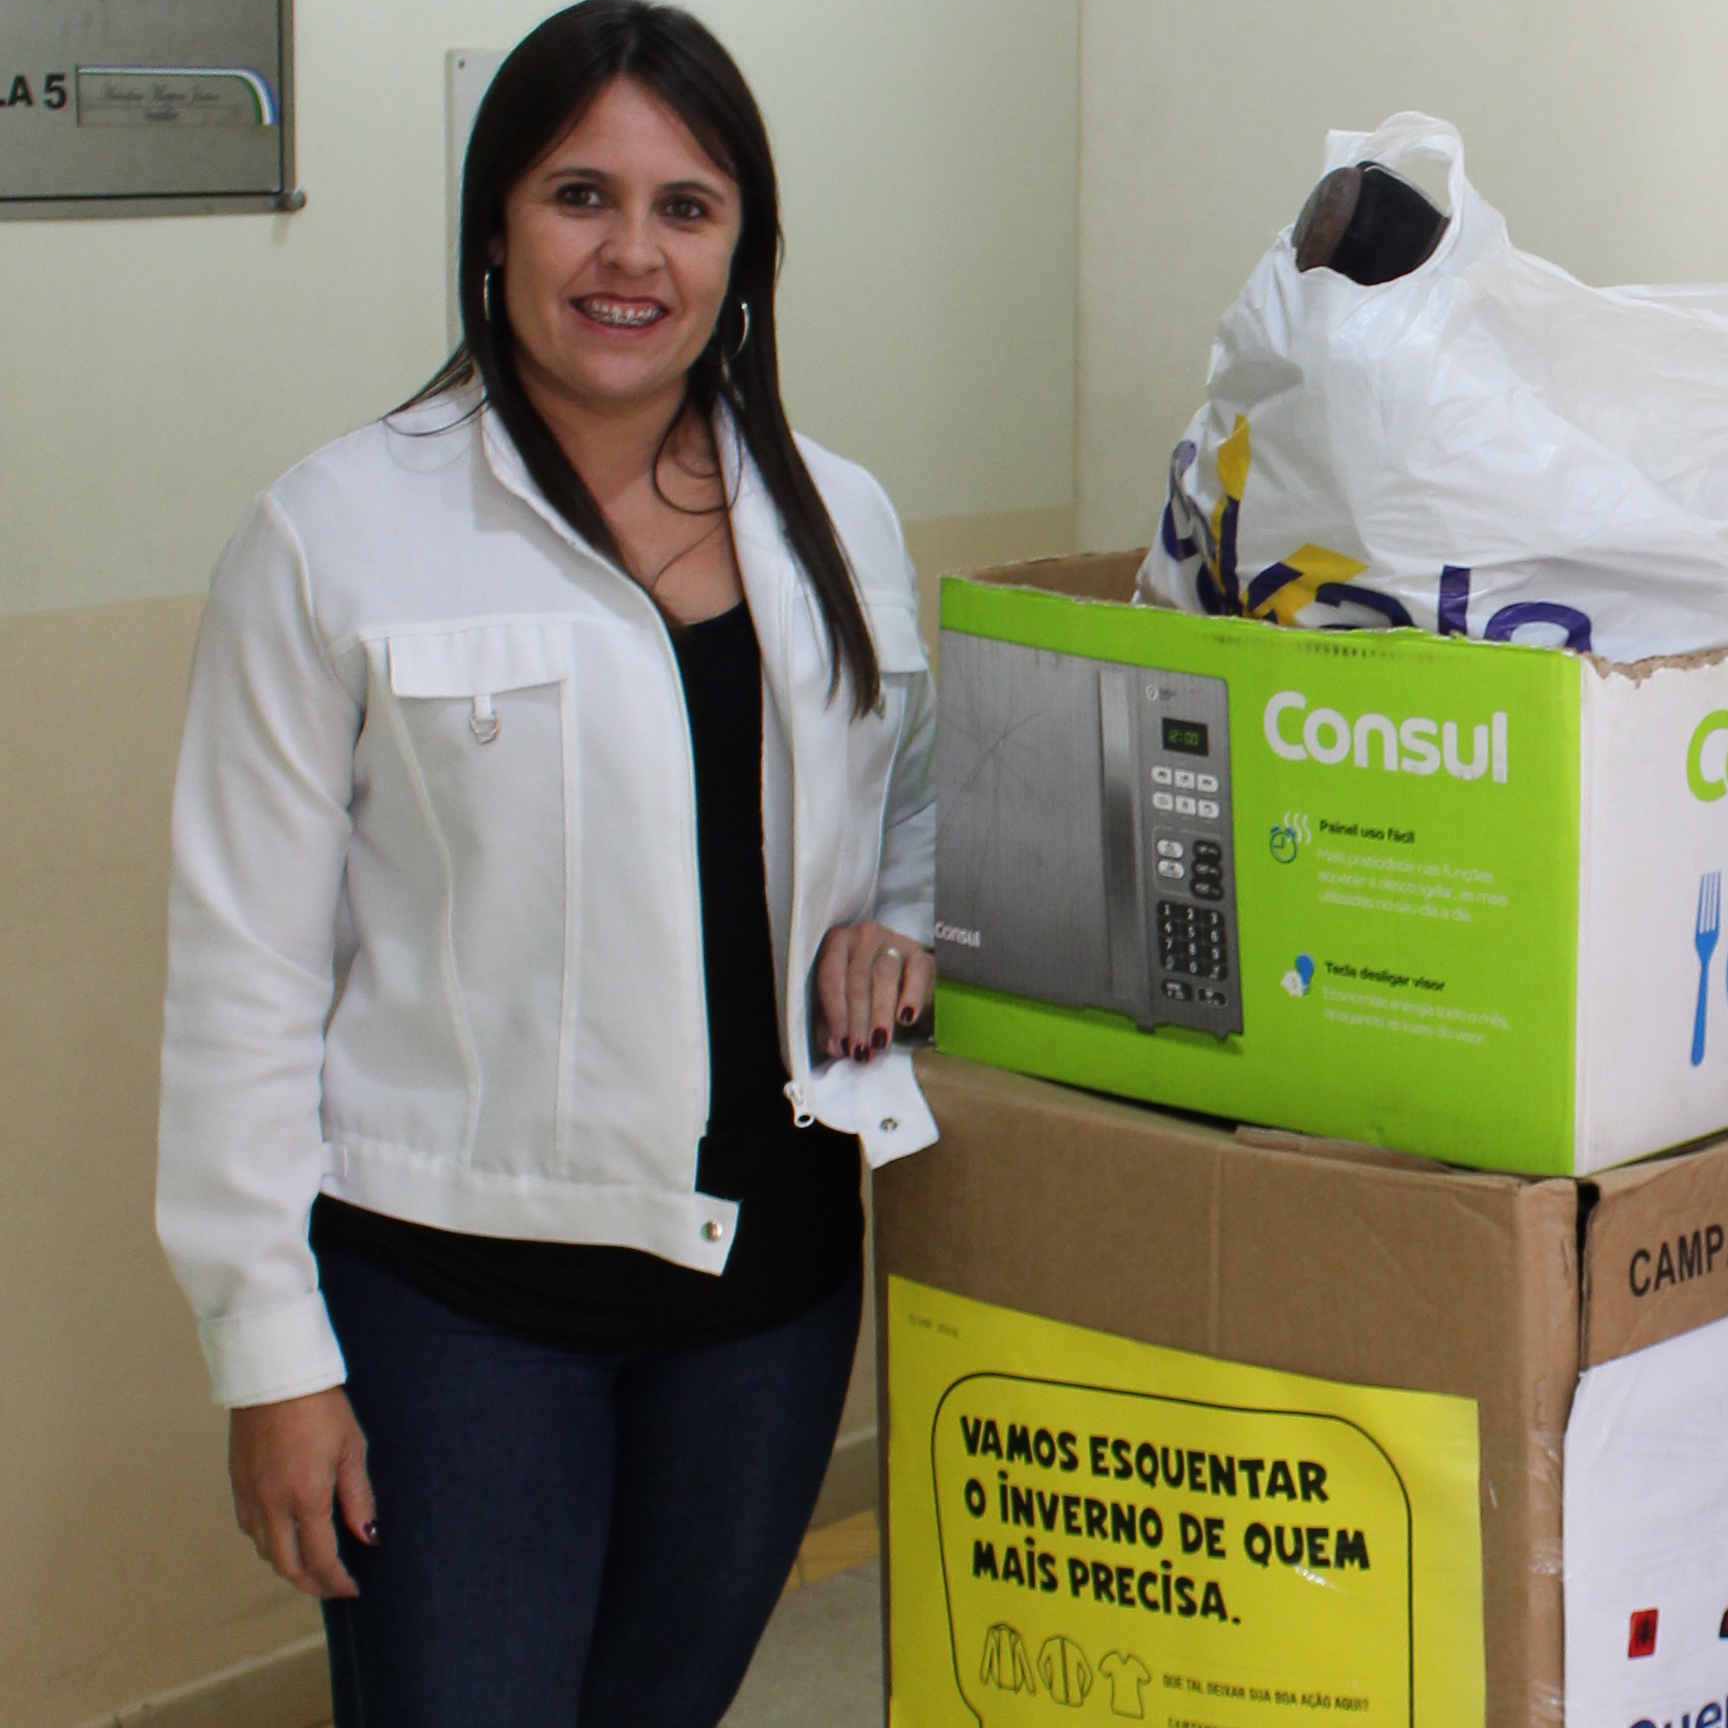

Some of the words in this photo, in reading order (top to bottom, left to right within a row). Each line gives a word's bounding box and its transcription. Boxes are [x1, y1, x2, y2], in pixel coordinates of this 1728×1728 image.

[0, 75, 34, 108] A
[43, 74, 68, 110] 5
[1263, 689, 1509, 784] Consul
[1319, 820, 1358, 839] Painel
[1361, 826, 1384, 840] uso
[960, 1414, 1079, 1472] VAMOS
[1089, 1435, 1329, 1503] ESQUENTAR
[964, 1479, 985, 1517] O
[1179, 1512, 1226, 1559] DE
[1243, 1525, 1371, 1570] QUEM
[1162, 1674, 1182, 1690] QUE
[1185, 1678, 1204, 1694] TAL
[1206, 1681, 1245, 1698] DEIXAR
[1248, 1687, 1271, 1702] SUA
[1274, 1690, 1297, 1705] BOA
